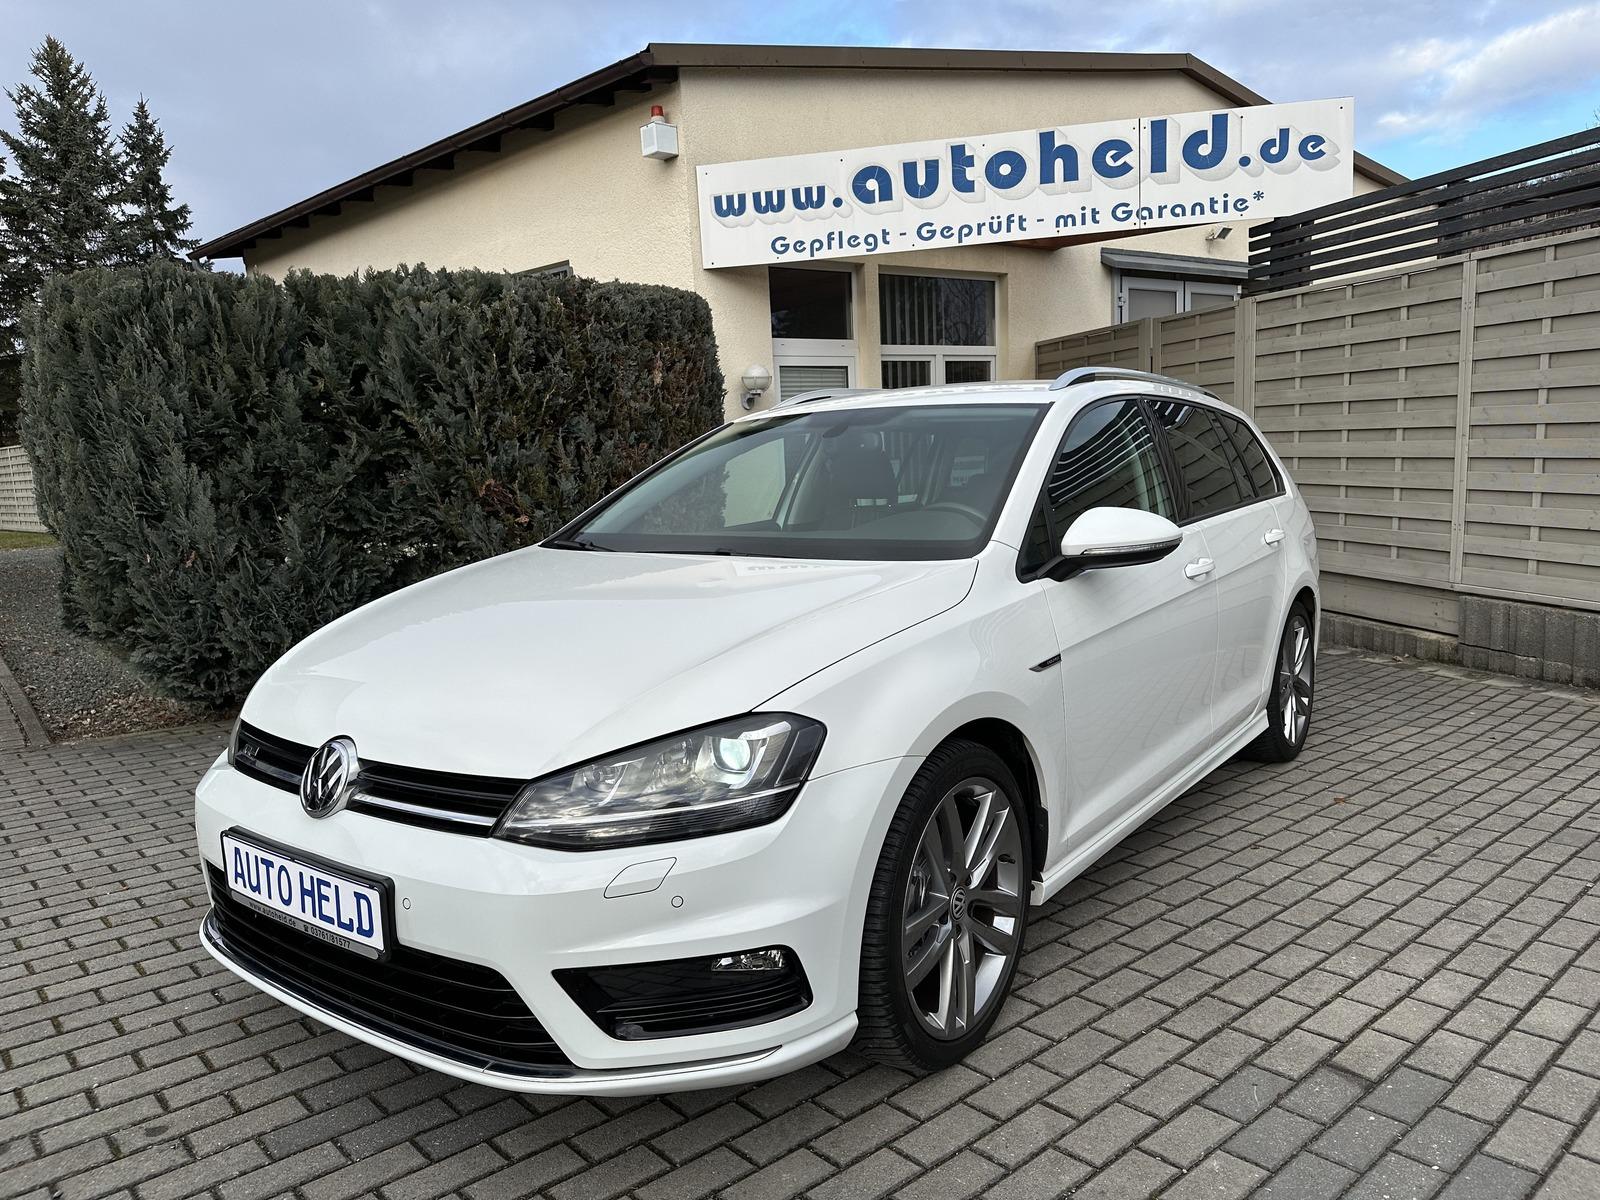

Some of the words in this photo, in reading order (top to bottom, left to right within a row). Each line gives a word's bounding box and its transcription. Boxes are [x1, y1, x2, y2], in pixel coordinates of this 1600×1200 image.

[713, 112, 1327, 218] www.autoheld.de
[770, 228, 890, 258] Gepflegt
[916, 213, 1027, 244] Geprüft
[1055, 205, 1100, 229] mit
[234, 846, 293, 907] AUTO
[299, 871, 375, 938] HELD
